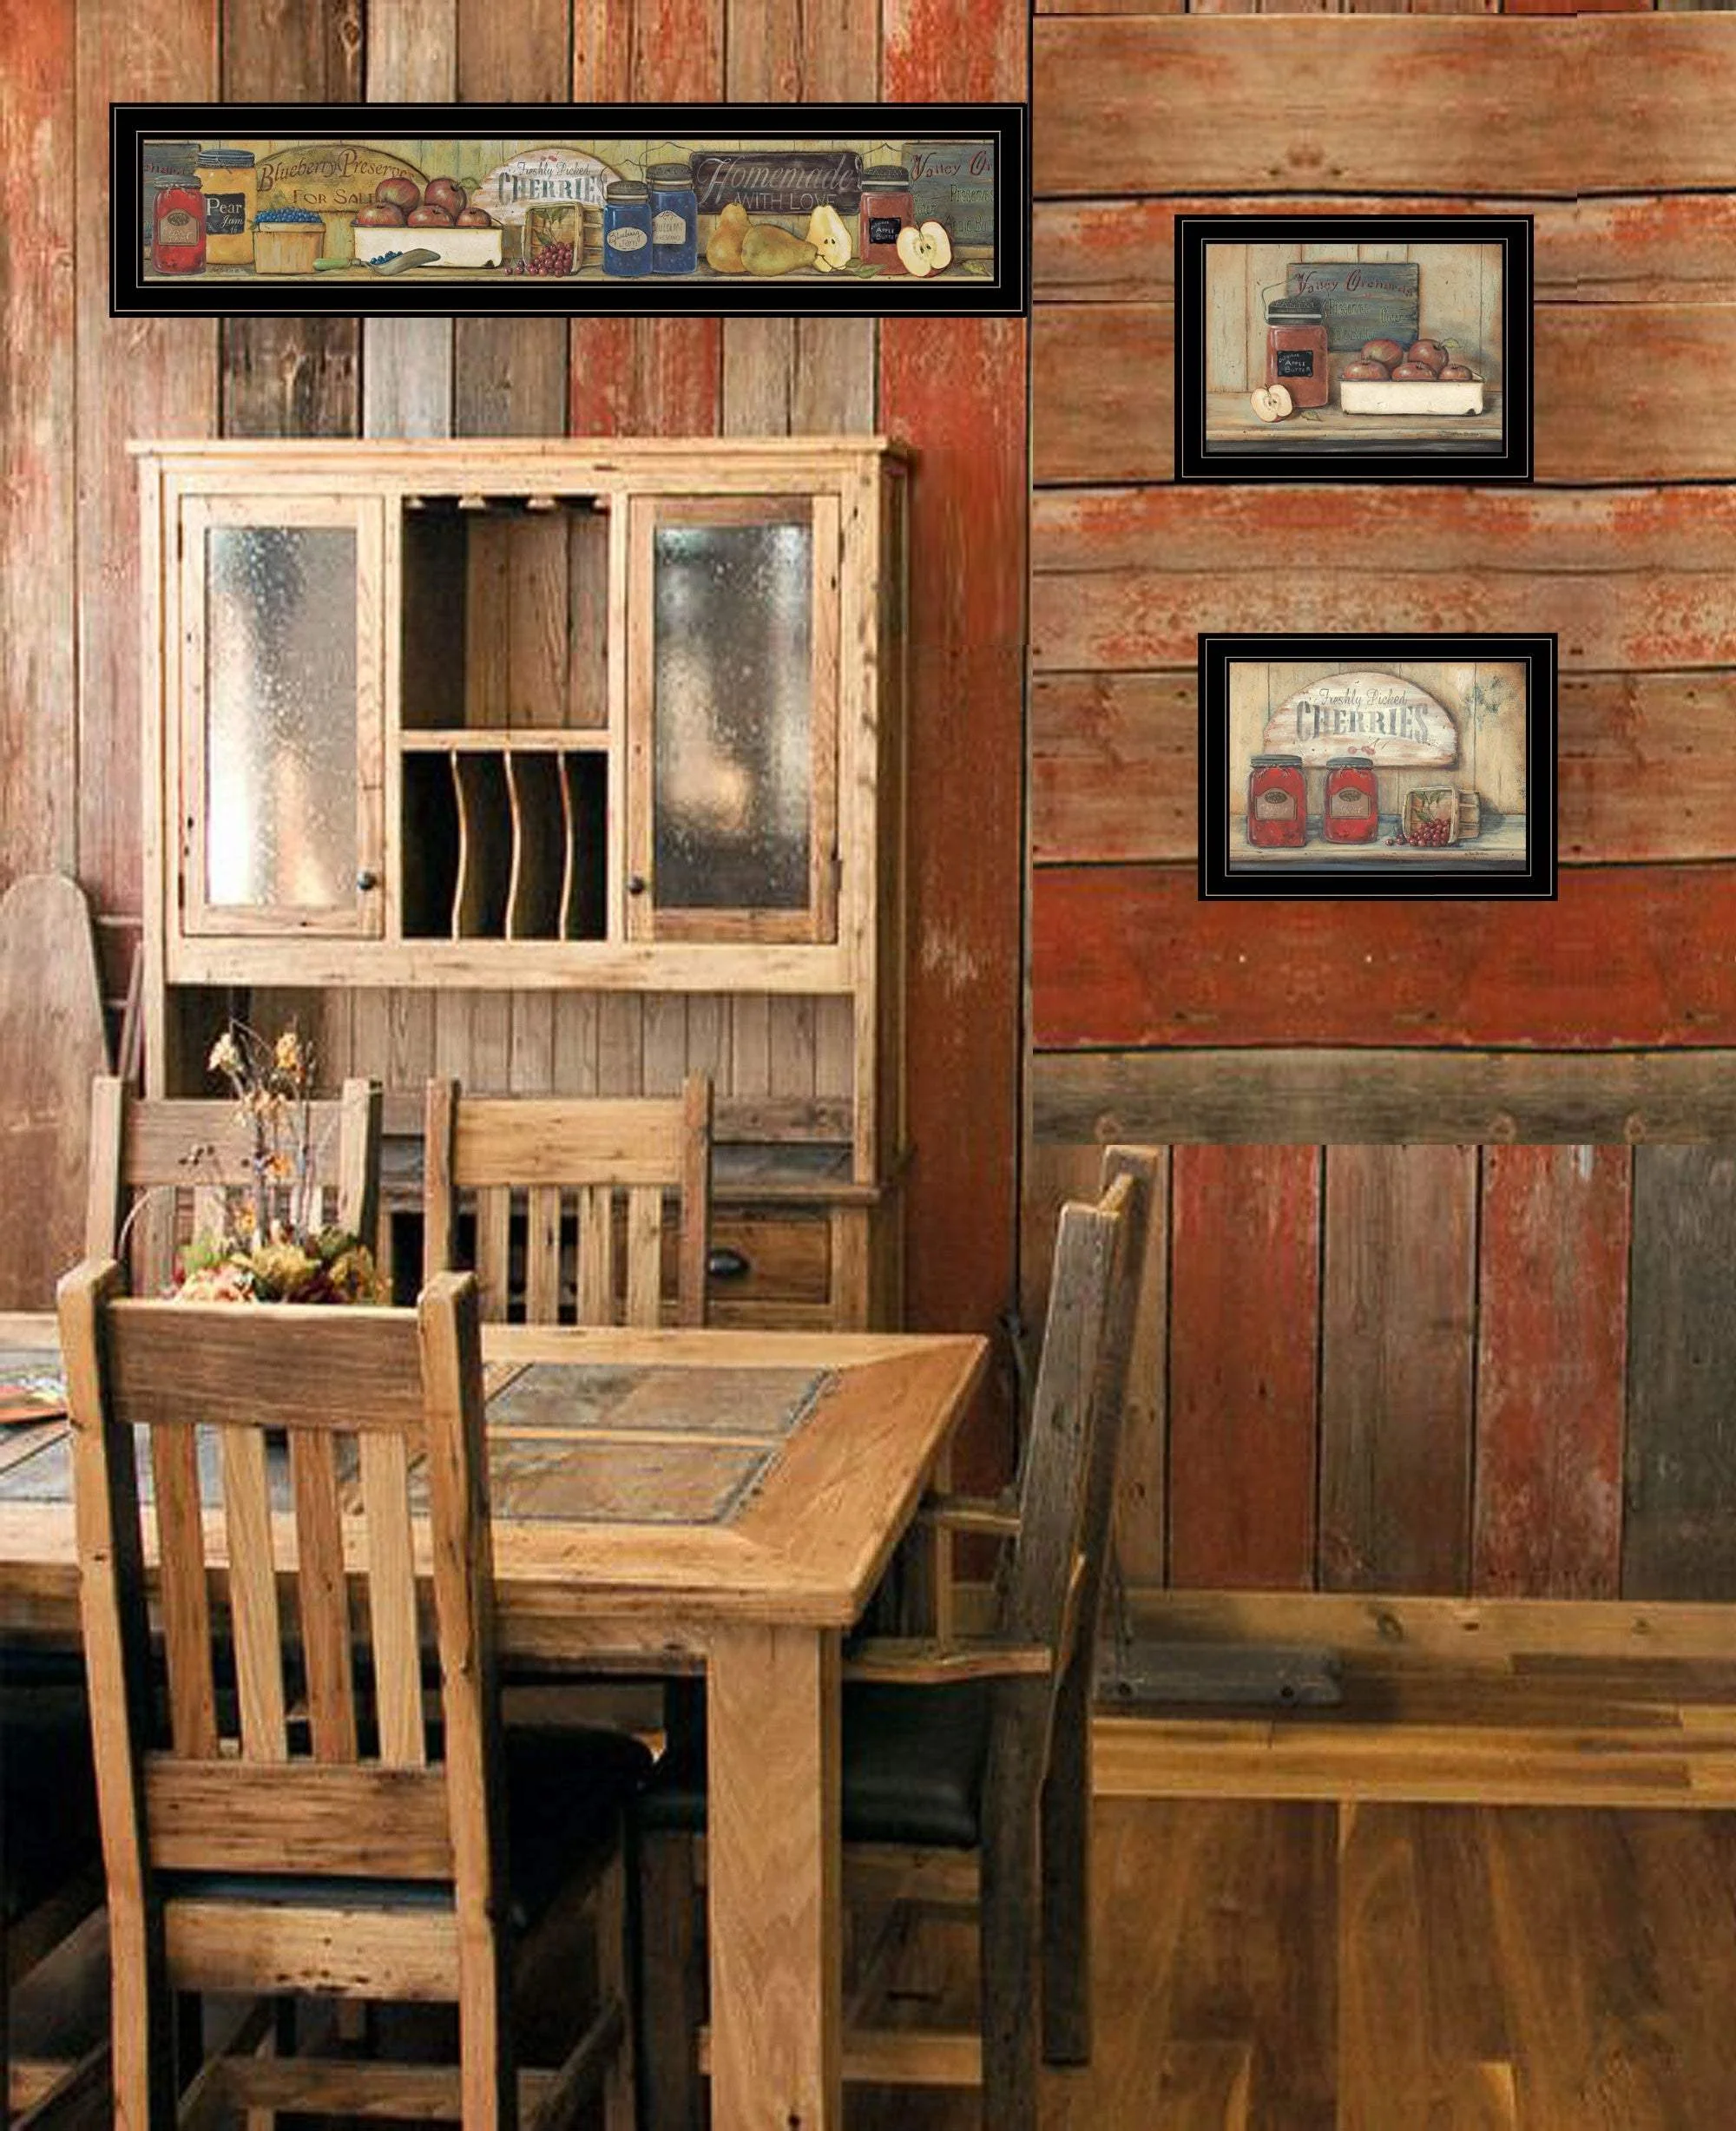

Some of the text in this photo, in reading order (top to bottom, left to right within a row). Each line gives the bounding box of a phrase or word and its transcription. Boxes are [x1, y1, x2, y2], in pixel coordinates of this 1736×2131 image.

[258, 158, 341, 192] Blueberry
[517, 161, 591, 180] Freshly Picked
[911, 152, 962, 181] Valley
[696, 154, 862, 205] Homemade
[288, 189, 326, 205] FOR
[734, 192, 837, 210] WITH LOVE
[206, 198, 242, 216] Pear
[220, 214, 244, 228] Jam
[1318, 687, 1409, 707] Freshly Picked
[1296, 700, 1430, 745] CHERRIES
